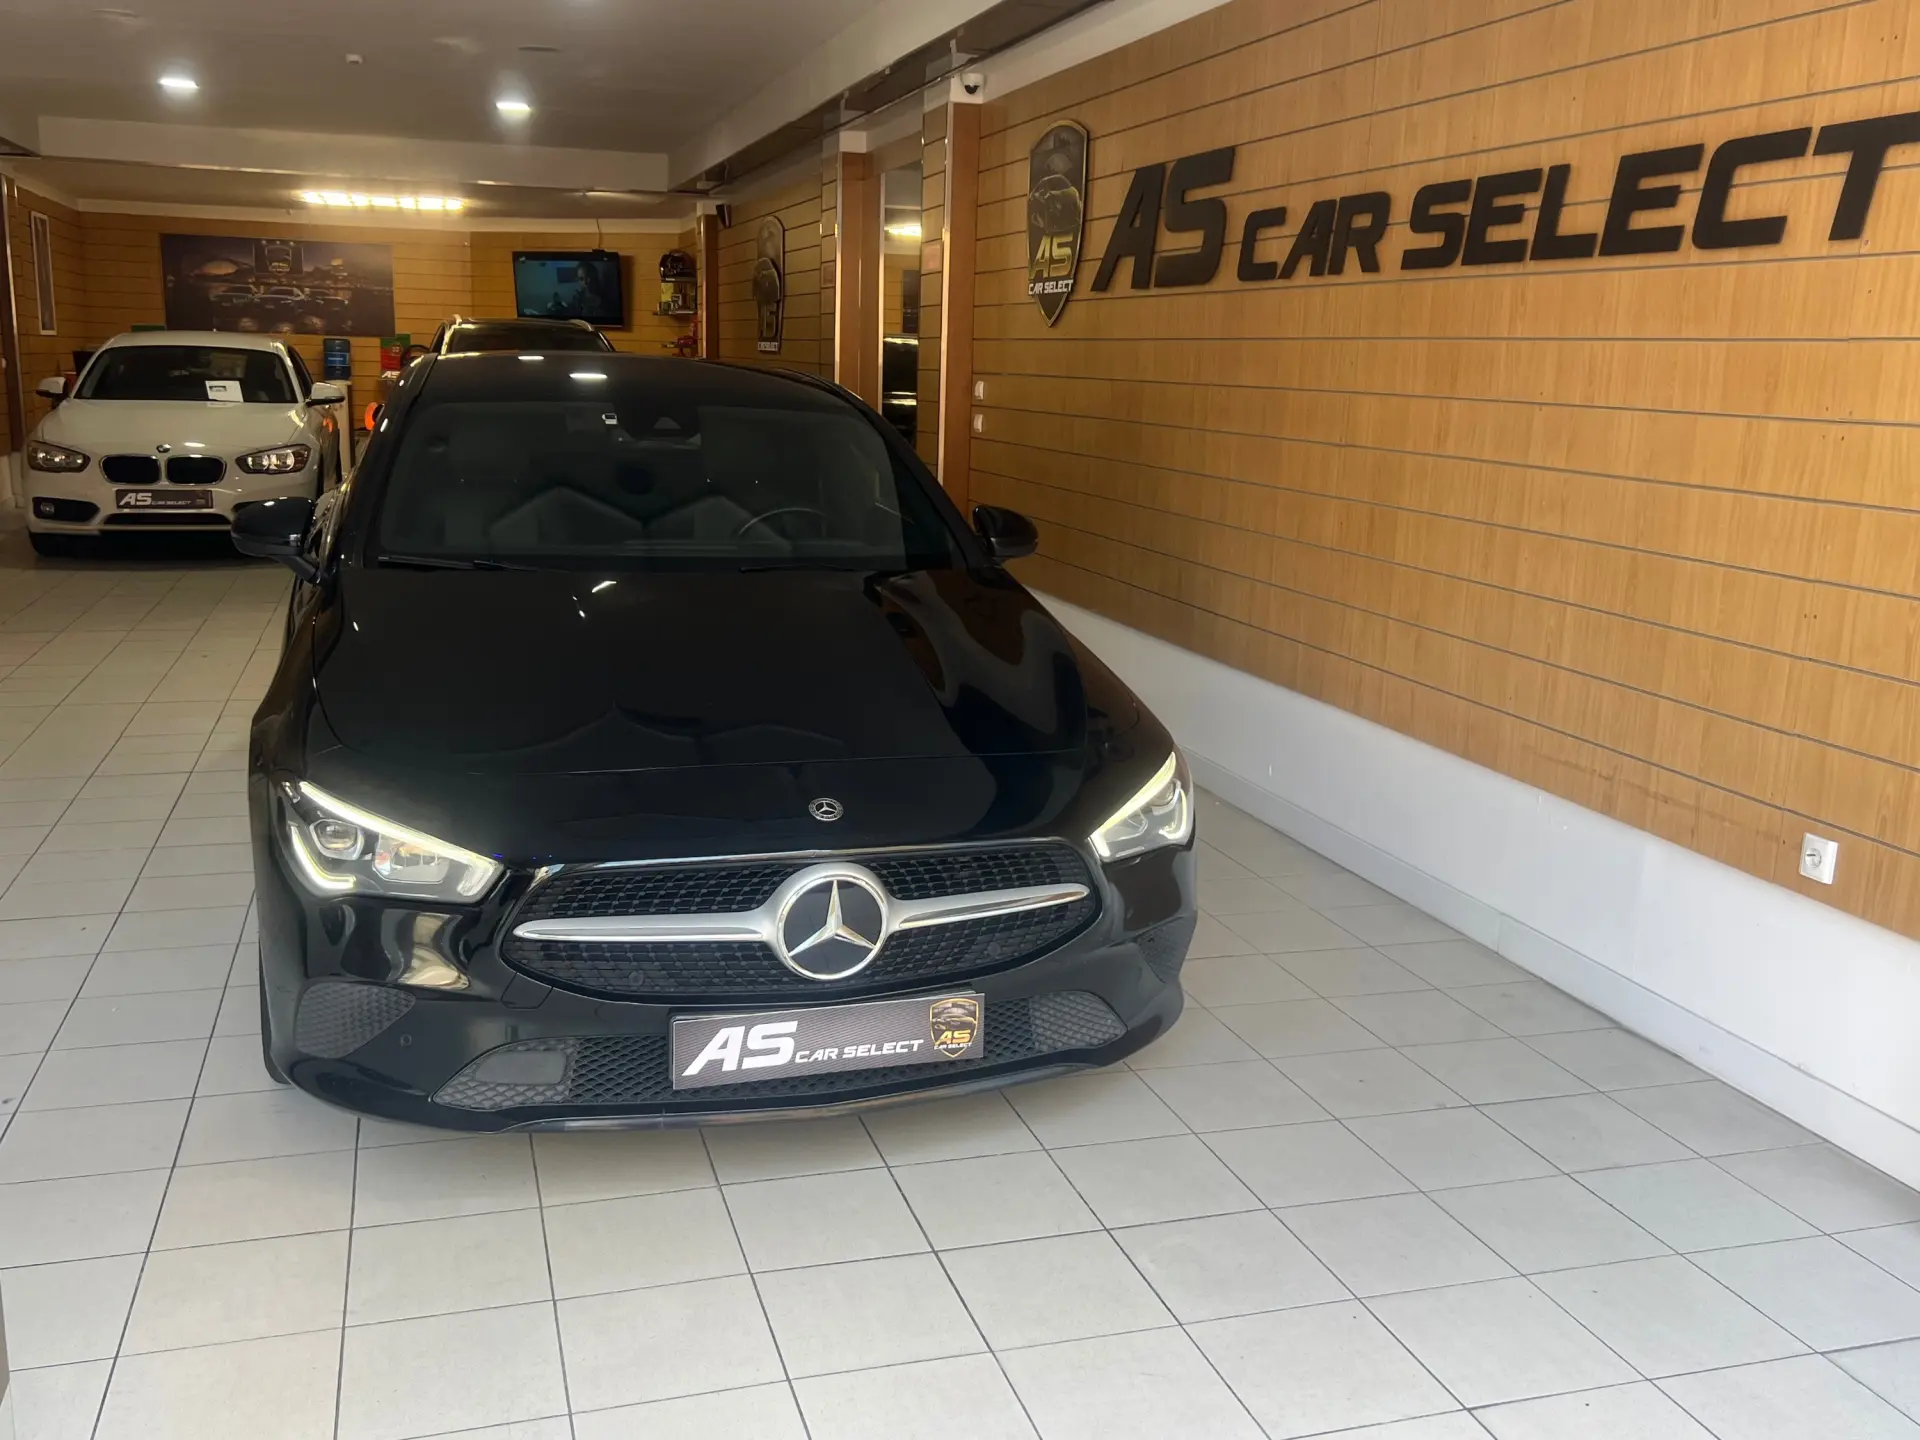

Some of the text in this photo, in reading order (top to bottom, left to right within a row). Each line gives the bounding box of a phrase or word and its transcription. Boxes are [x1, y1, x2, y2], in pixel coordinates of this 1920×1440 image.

[1090, 111, 1920, 292] AS CAR SELECT
[1028, 234, 1074, 279] AS
[1028, 280, 1073, 295] CAR SELECT
[119, 492, 152, 505] AS
[681, 1020, 925, 1077] AS CAR SELECT
[935, 1030, 971, 1046] AS
